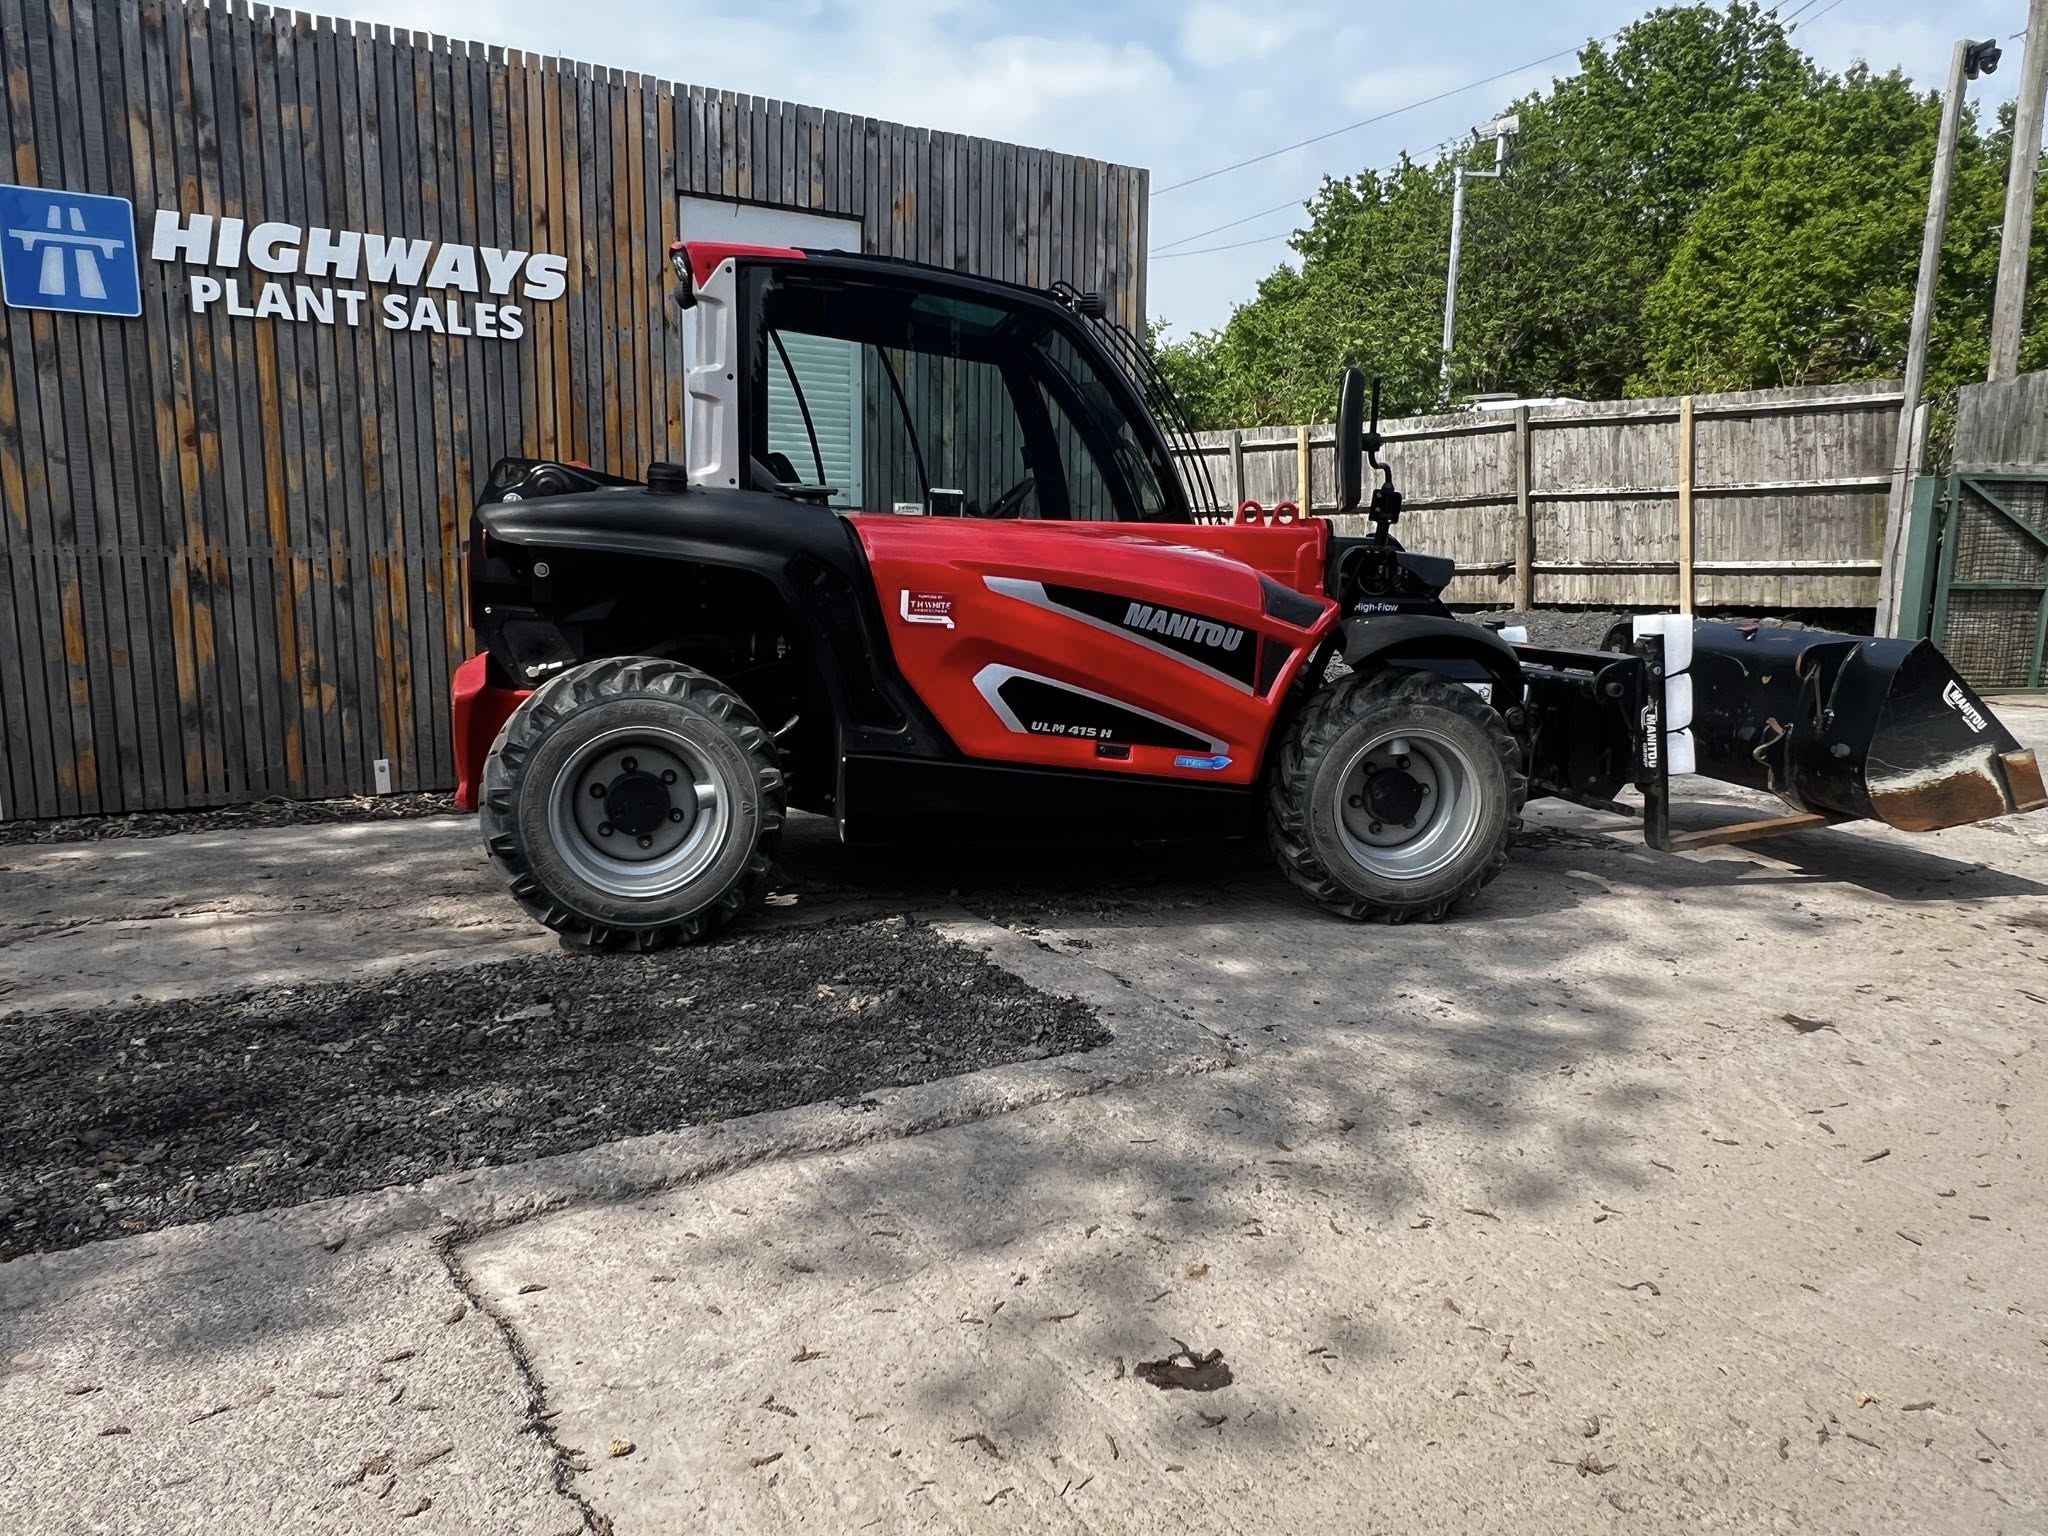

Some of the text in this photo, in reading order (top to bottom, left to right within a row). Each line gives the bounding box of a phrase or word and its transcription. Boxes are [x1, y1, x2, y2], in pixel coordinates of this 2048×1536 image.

[152, 209, 568, 300] HIGHWAYS
[190, 275, 524, 340] PLANT SALES
[1123, 602, 1244, 652] MANITOU
[1354, 602, 1399, 613] High-Flow
[1031, 721, 1113, 739] ULM 415 H
[1949, 689, 1988, 730] MANITOU
[1646, 714, 1658, 768] MANITOU
